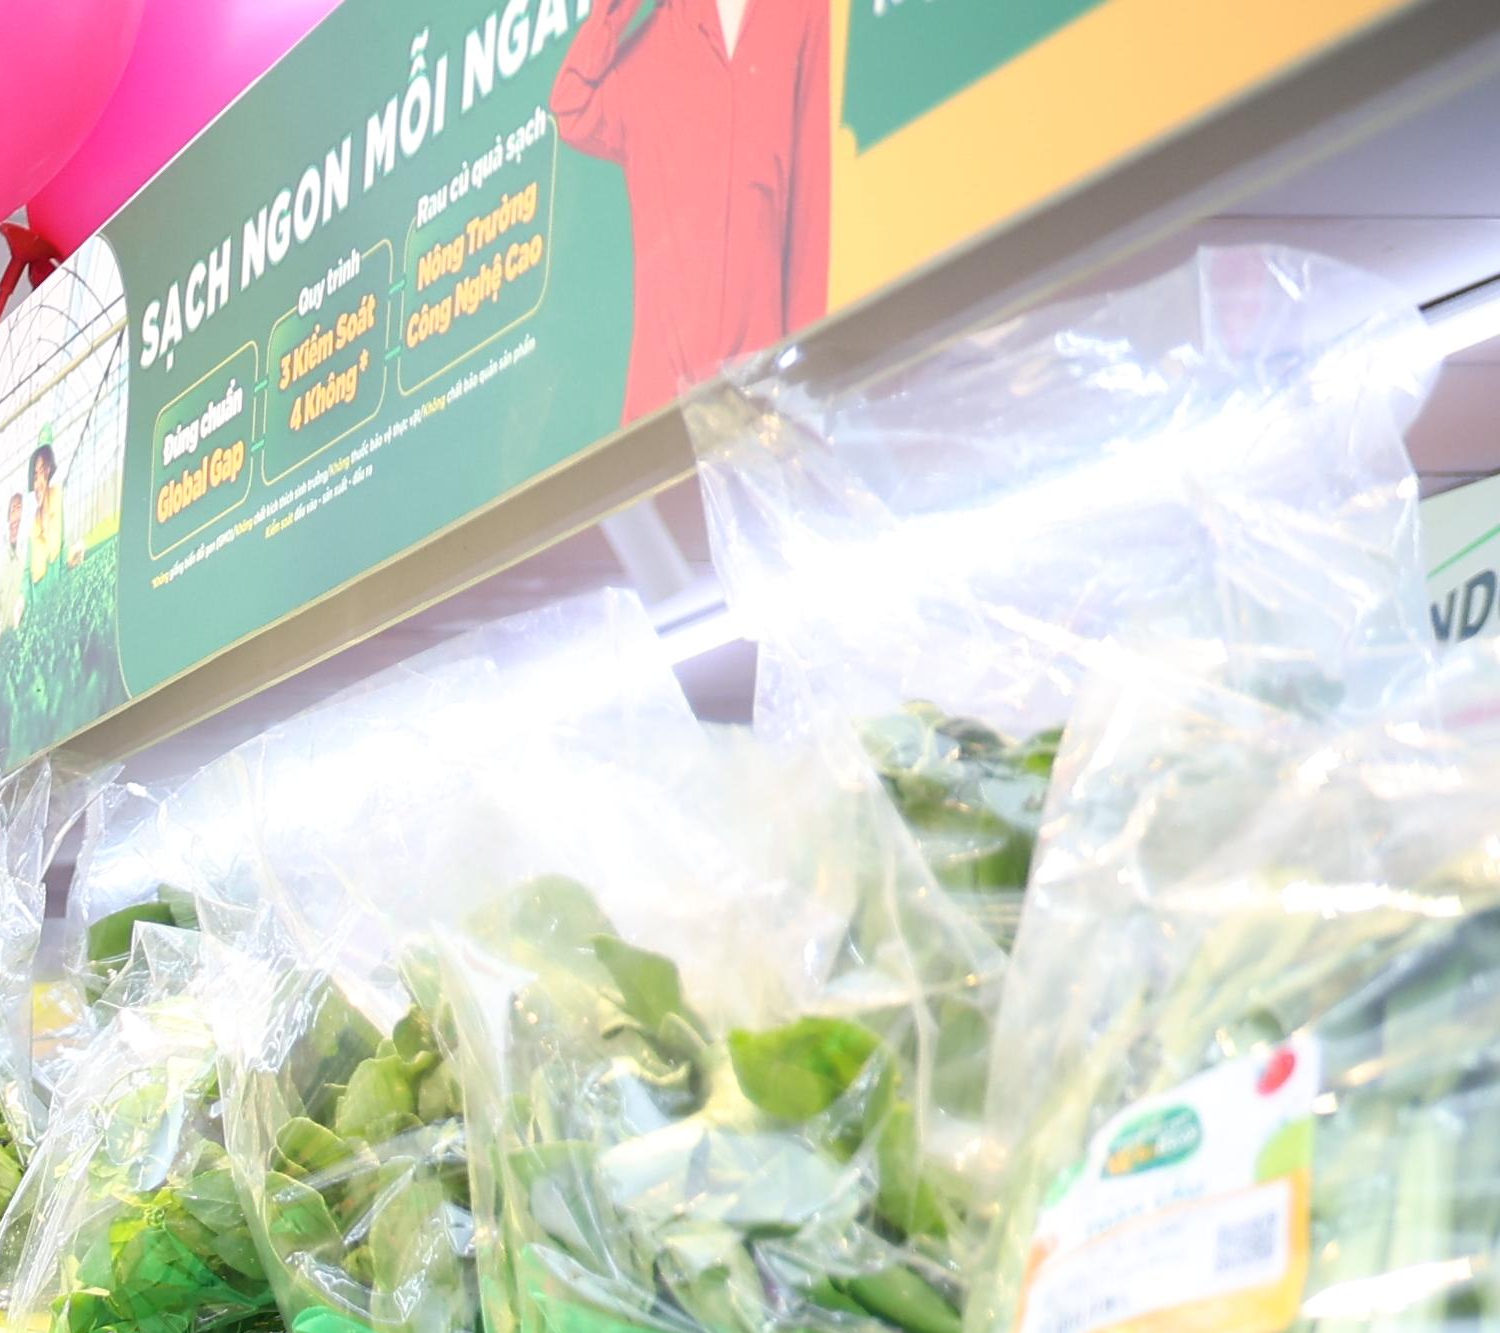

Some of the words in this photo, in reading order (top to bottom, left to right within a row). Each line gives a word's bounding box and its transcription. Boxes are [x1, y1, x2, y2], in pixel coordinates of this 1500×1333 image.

[138, 236, 232, 372] SẠCH
[240, 131, 353, 292] NGON
[362, 25, 449, 194] MỖI
[415, 184, 447, 228] Rau
[470, 144, 504, 192] quả
[504, 104, 547, 164] sạch
[298, 282, 327, 317] Quy
[404, 297, 453, 348] Công
[453, 259, 503, 323] Nghệ
[503, 233, 544, 282] Cao
[416, 236, 464, 291] Nông
[279, 356, 292, 391] 3
[335, 294, 377, 350] Soát
[162, 417, 200, 467] Đúng
[200, 378, 244, 439] chuẩn
[289, 397, 304, 431] 4
[155, 456, 208, 524] Global
[208, 440, 245, 487] Gap
